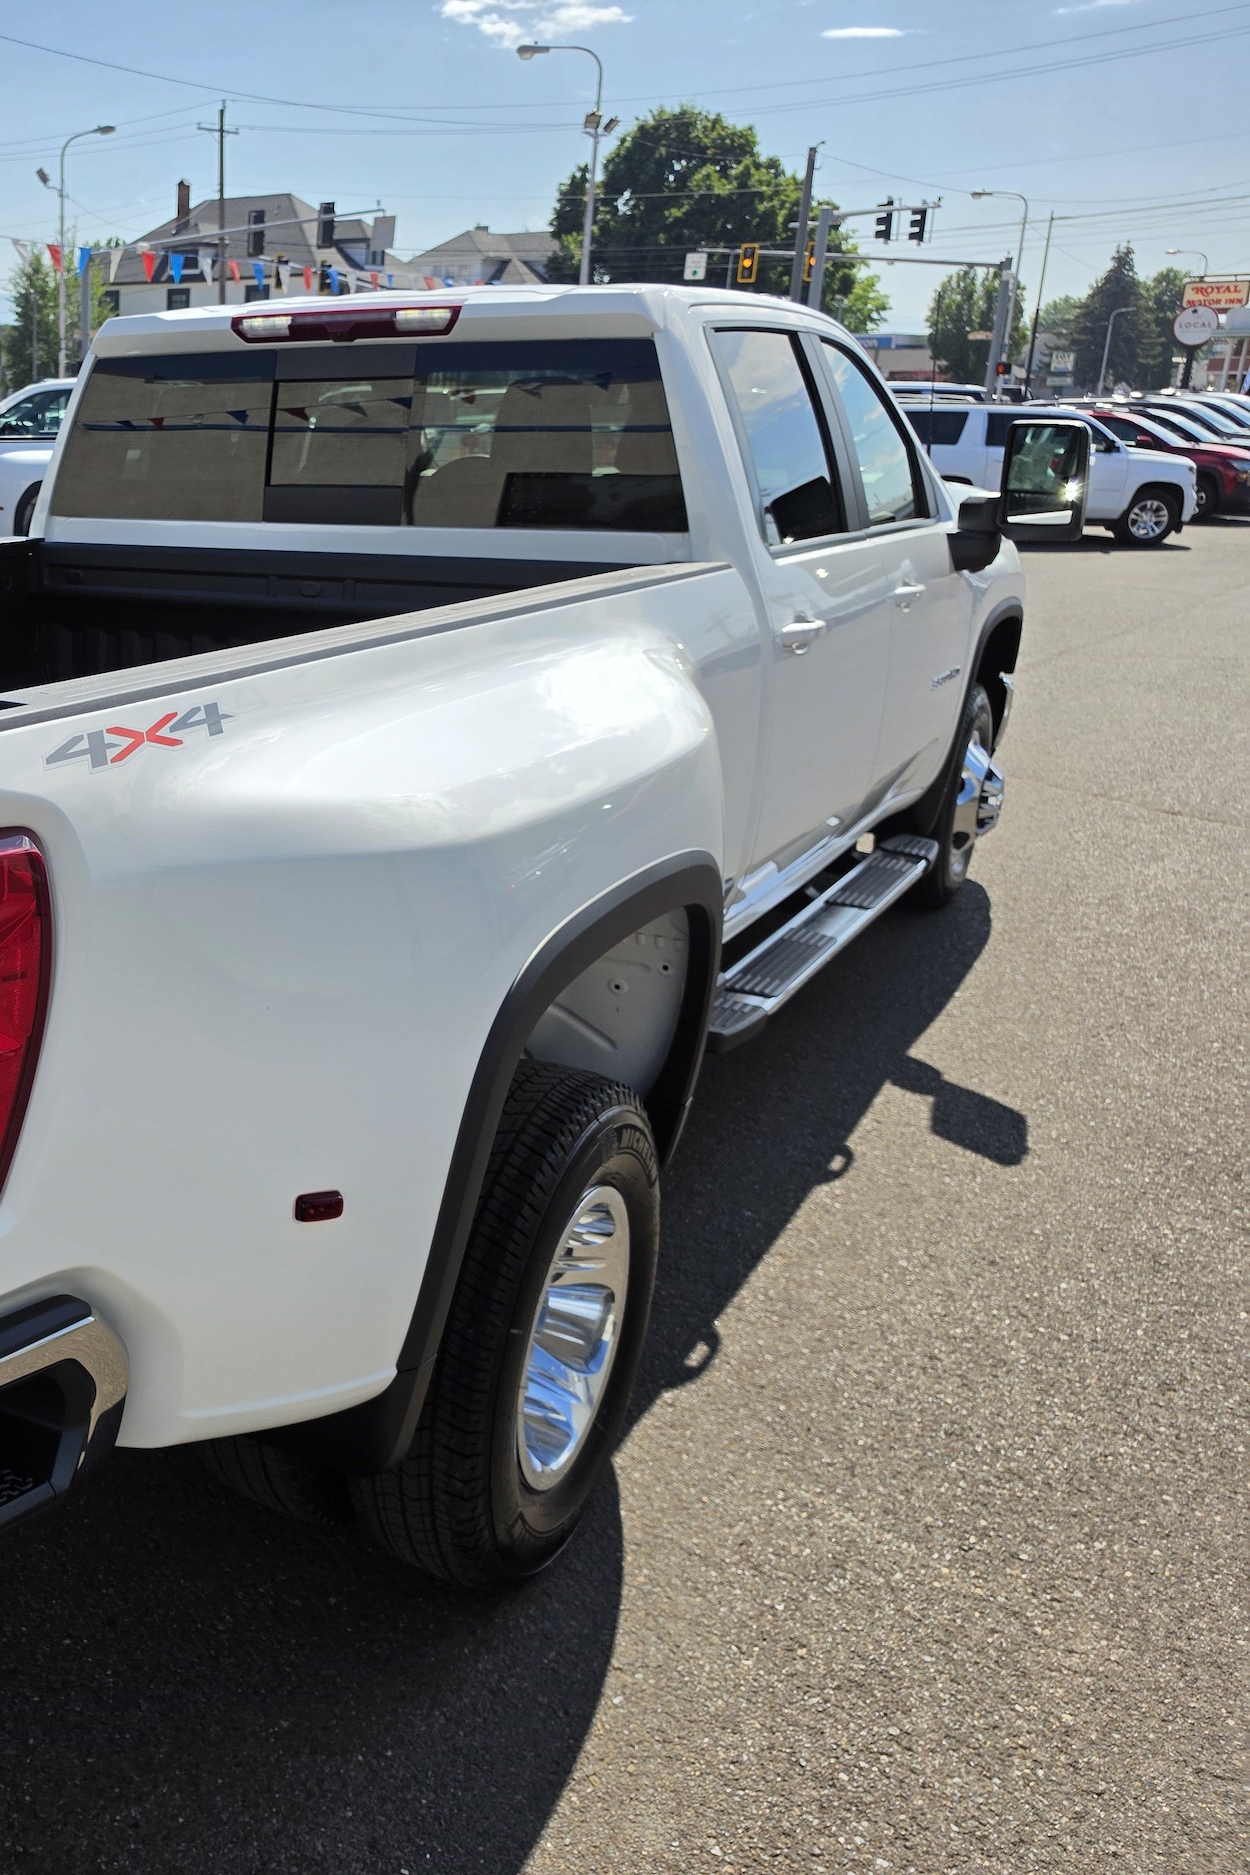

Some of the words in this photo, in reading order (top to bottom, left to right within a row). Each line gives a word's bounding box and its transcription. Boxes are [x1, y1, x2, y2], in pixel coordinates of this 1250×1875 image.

[1192, 284, 1242, 297] ROYAL
[1186, 298, 1222, 307] MOTOR
[1225, 297, 1244, 305] INN
[1179, 321, 1212, 329] LOCAL
[620, 1127, 658, 1183] MICHELIN
